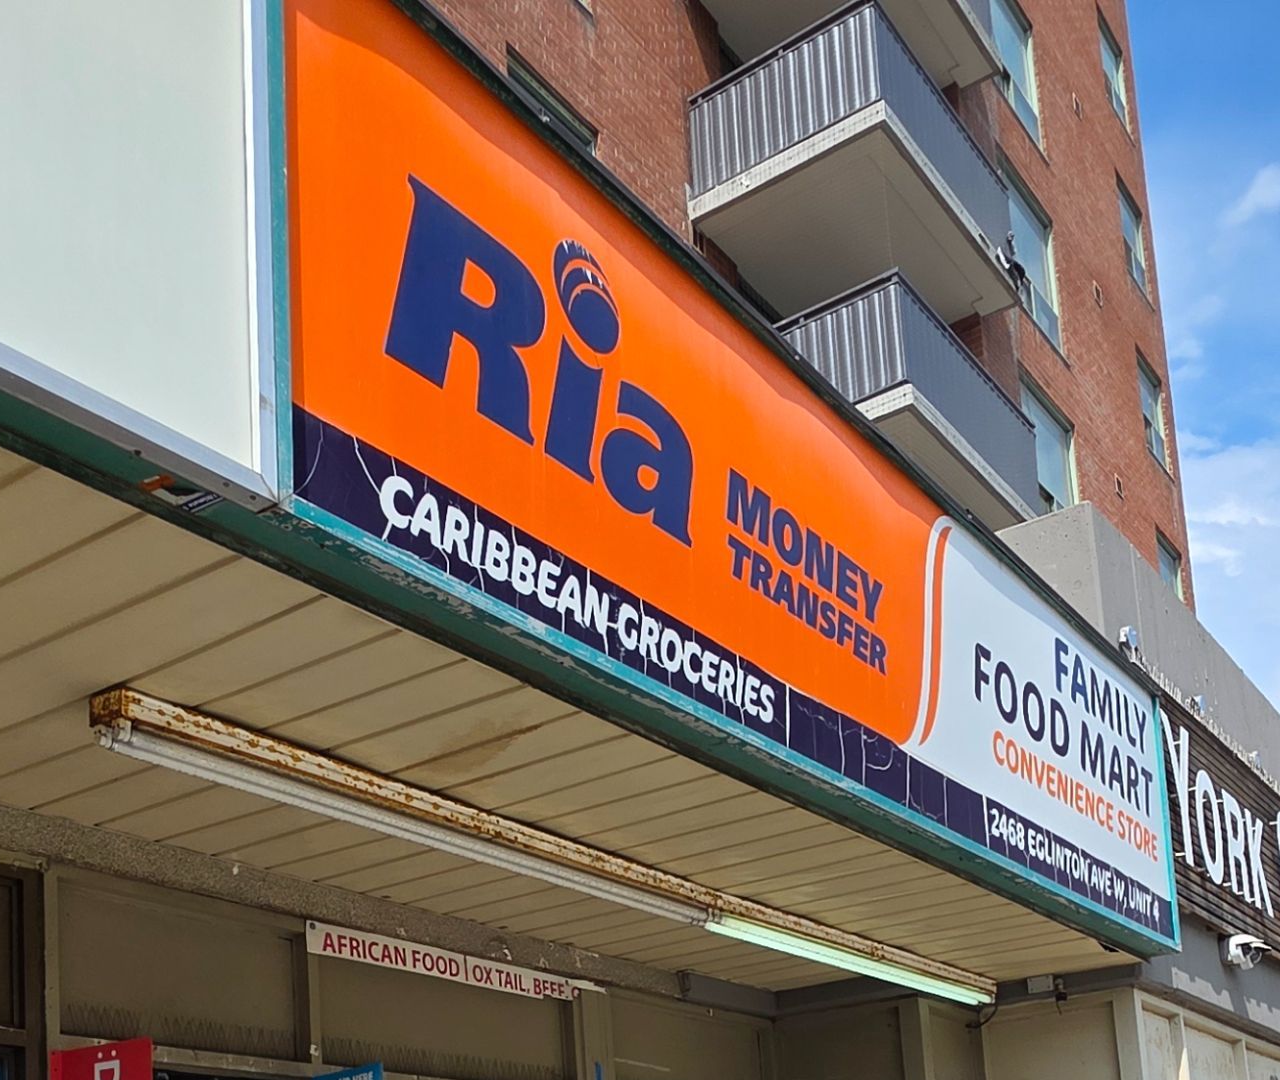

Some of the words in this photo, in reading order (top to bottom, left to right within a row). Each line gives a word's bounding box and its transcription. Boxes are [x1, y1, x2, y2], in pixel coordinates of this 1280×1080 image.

[384, 172, 695, 549] Ria
[380, 475, 612, 636] CARIBBEAN
[617, 601, 775, 724] GROCERIES
[724, 466, 885, 624] MONEY
[726, 534, 888, 677] TRANSFER
[973, 642, 1070, 758] FOOD
[1079, 721, 1154, 818] MART
[1053, 636, 1148, 754] FAMILY
[990, 807, 1025, 851] 2468
[1028, 828, 1090, 883] EGLINTON
[1091, 864, 1113, 896] AVE
[1128, 884, 1153, 916] UNIT
[1153, 900, 1160, 922] 4
[992, 730, 1114, 831] CONVENIENCE
[1117, 809, 1159, 862] STORE
[1159, 706, 1276, 918] YORK
[322, 931, 407, 967] AFRICAN
[412, 950, 461, 977] FOOD
[472, 964, 494, 986] OX
